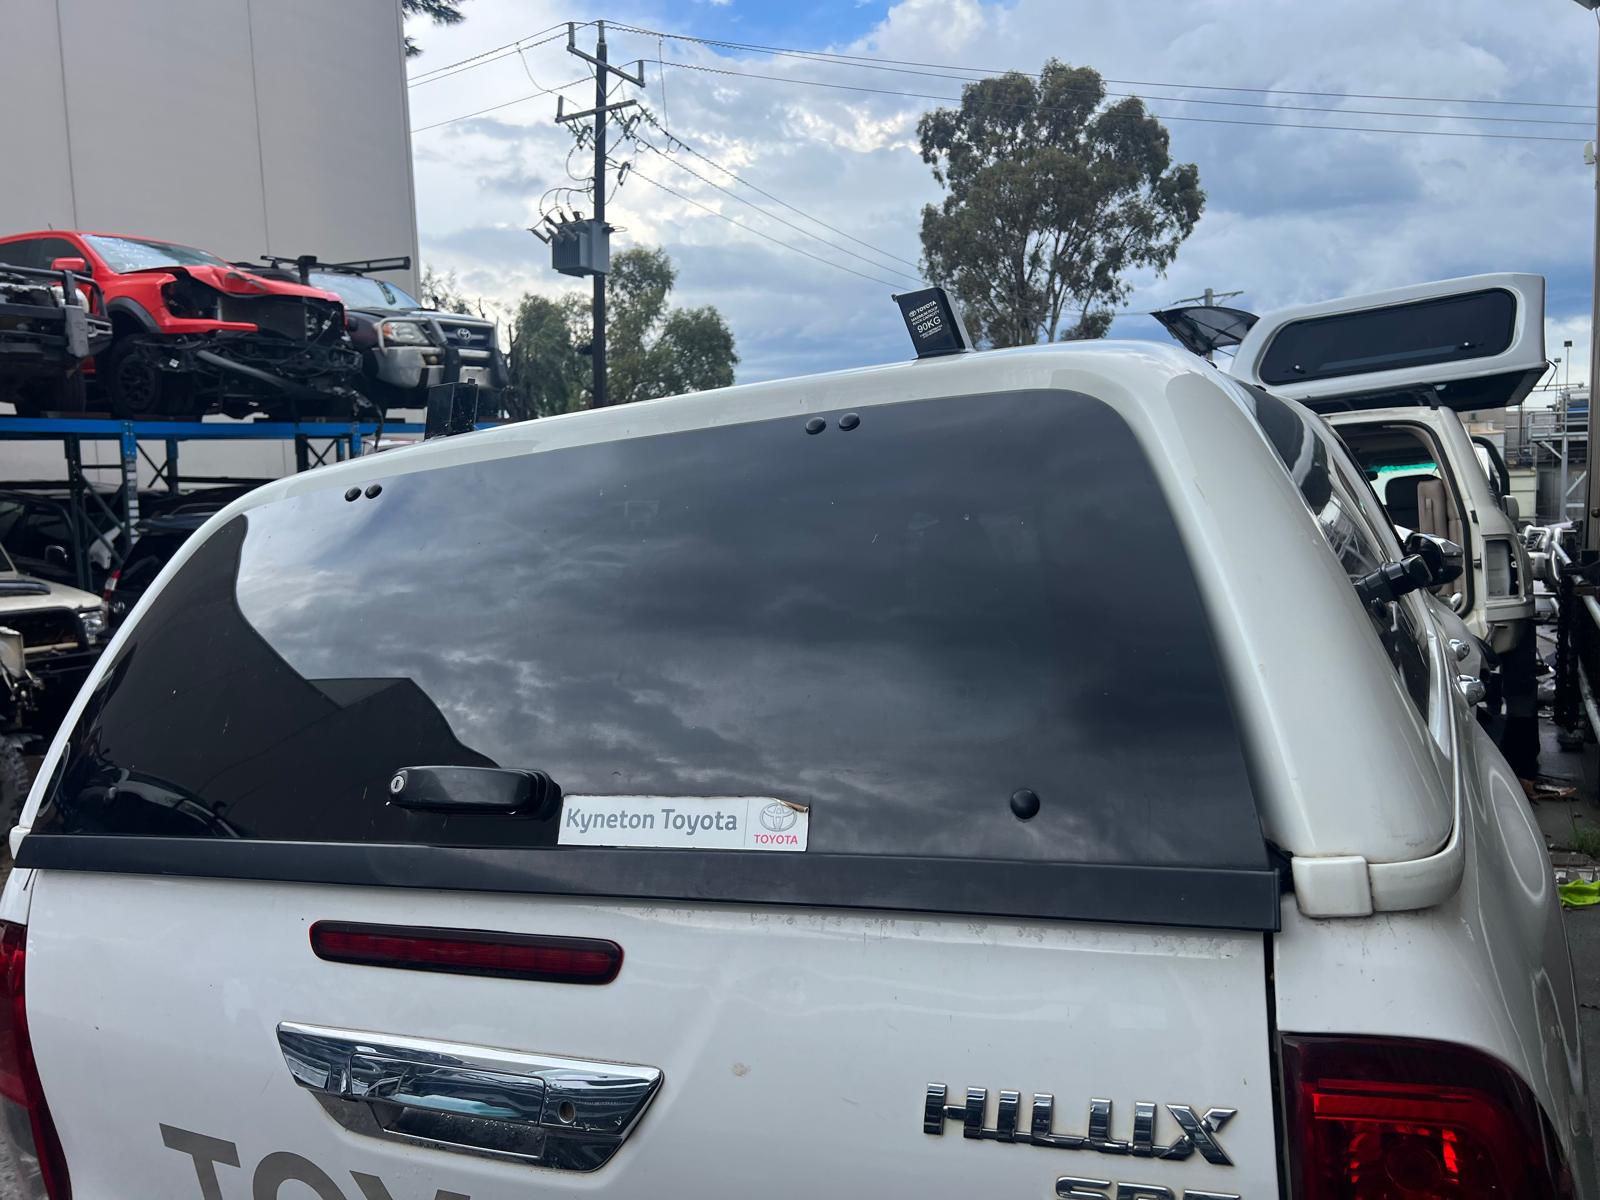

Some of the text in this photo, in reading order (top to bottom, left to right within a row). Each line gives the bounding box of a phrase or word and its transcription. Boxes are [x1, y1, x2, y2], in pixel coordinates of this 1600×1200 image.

[917, 301, 937, 313] TOYOTA
[917, 316, 941, 333] 90KG
[566, 808, 738, 835] Kyneton Toyota
[754, 834, 798, 845] TOYOTA
[924, 1082, 1238, 1166] HILUX
